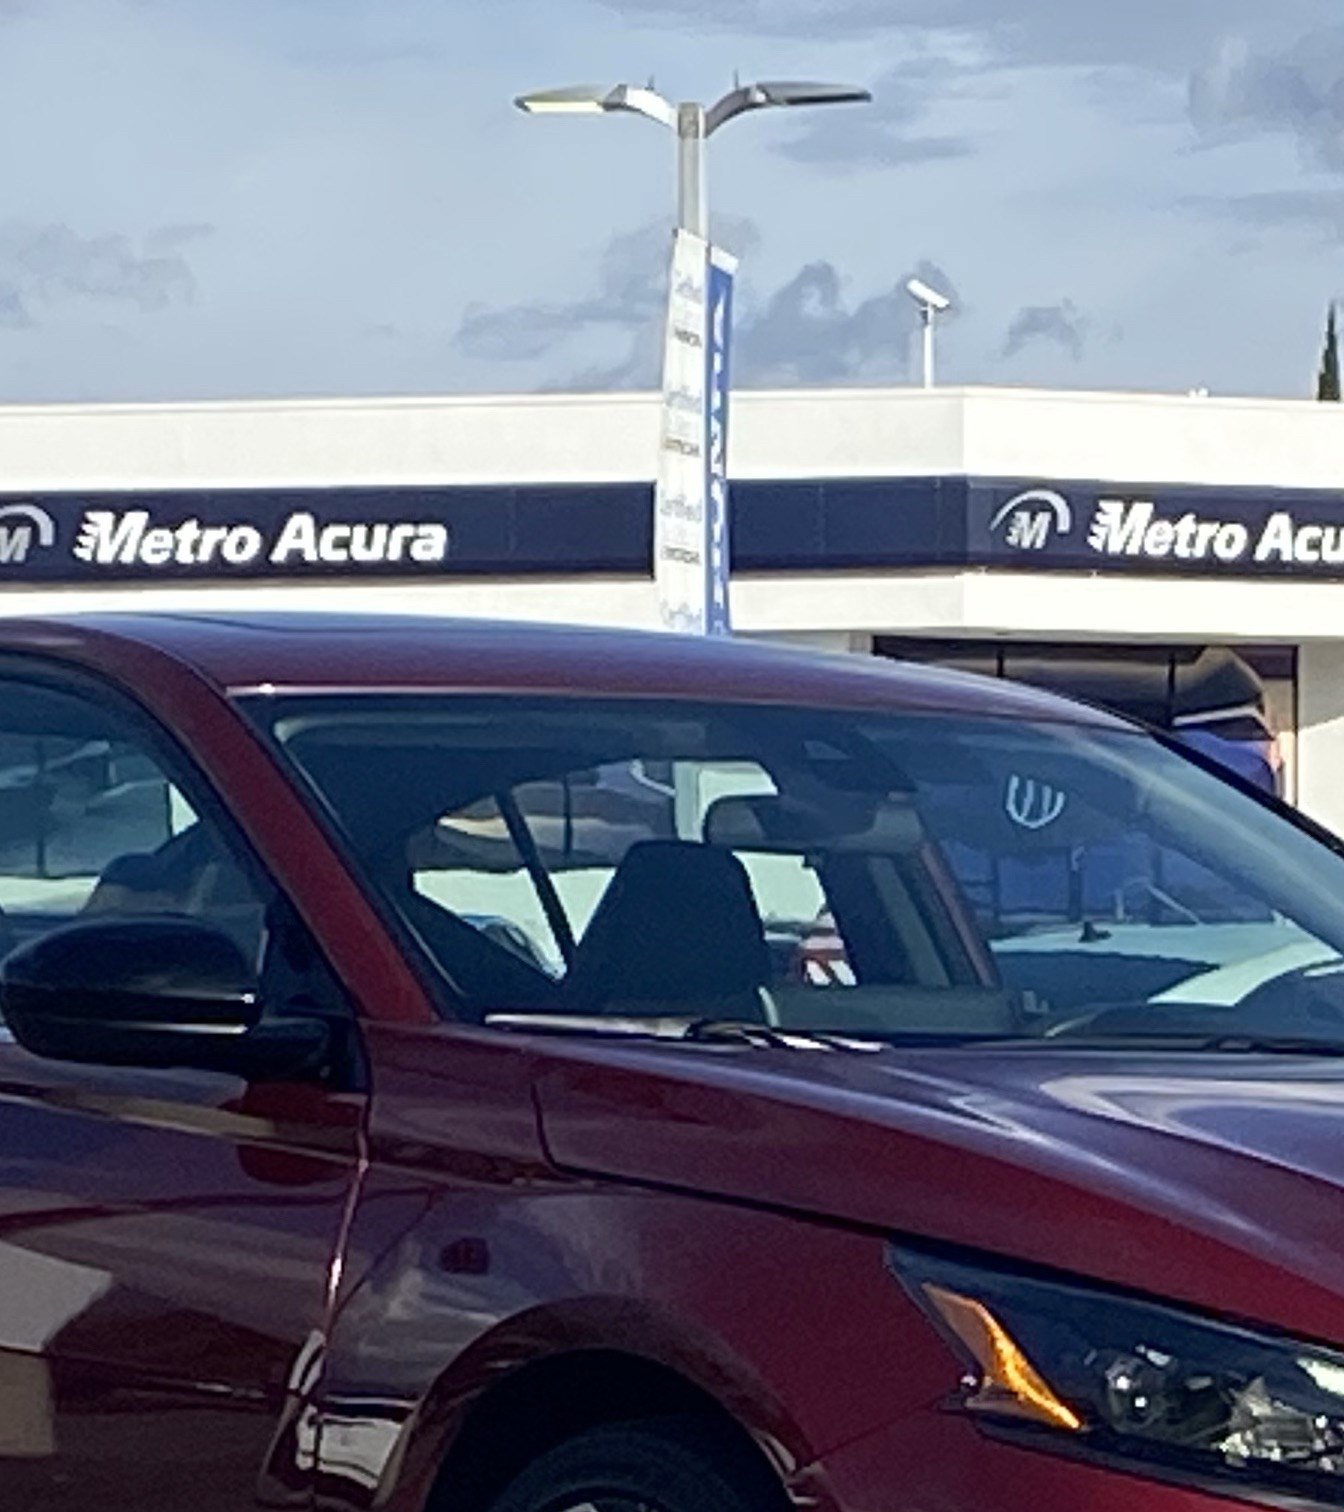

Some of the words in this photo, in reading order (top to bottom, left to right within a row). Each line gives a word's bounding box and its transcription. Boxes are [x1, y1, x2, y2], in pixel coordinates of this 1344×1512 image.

[73, 511, 261, 565] Metro
[270, 512, 448, 563] Acura
[1086, 499, 1240, 560] Metro
